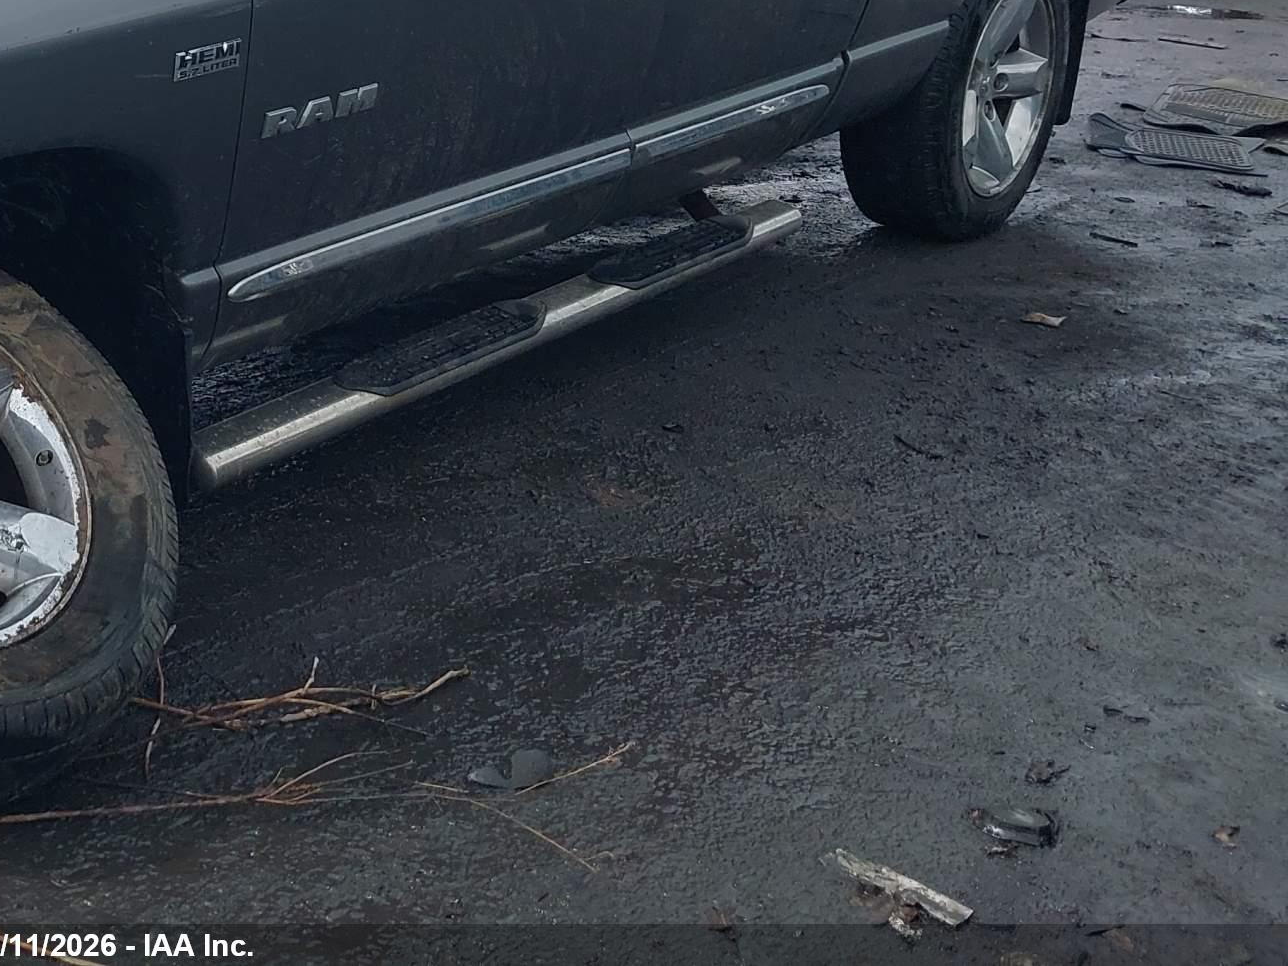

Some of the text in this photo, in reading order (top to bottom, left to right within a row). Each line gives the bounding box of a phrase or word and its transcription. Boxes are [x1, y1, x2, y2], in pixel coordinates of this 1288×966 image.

[175, 37, 242, 70] HEMI
[178, 58, 237, 80] 5.7 LITER
[261, 82, 379, 139] RAM
